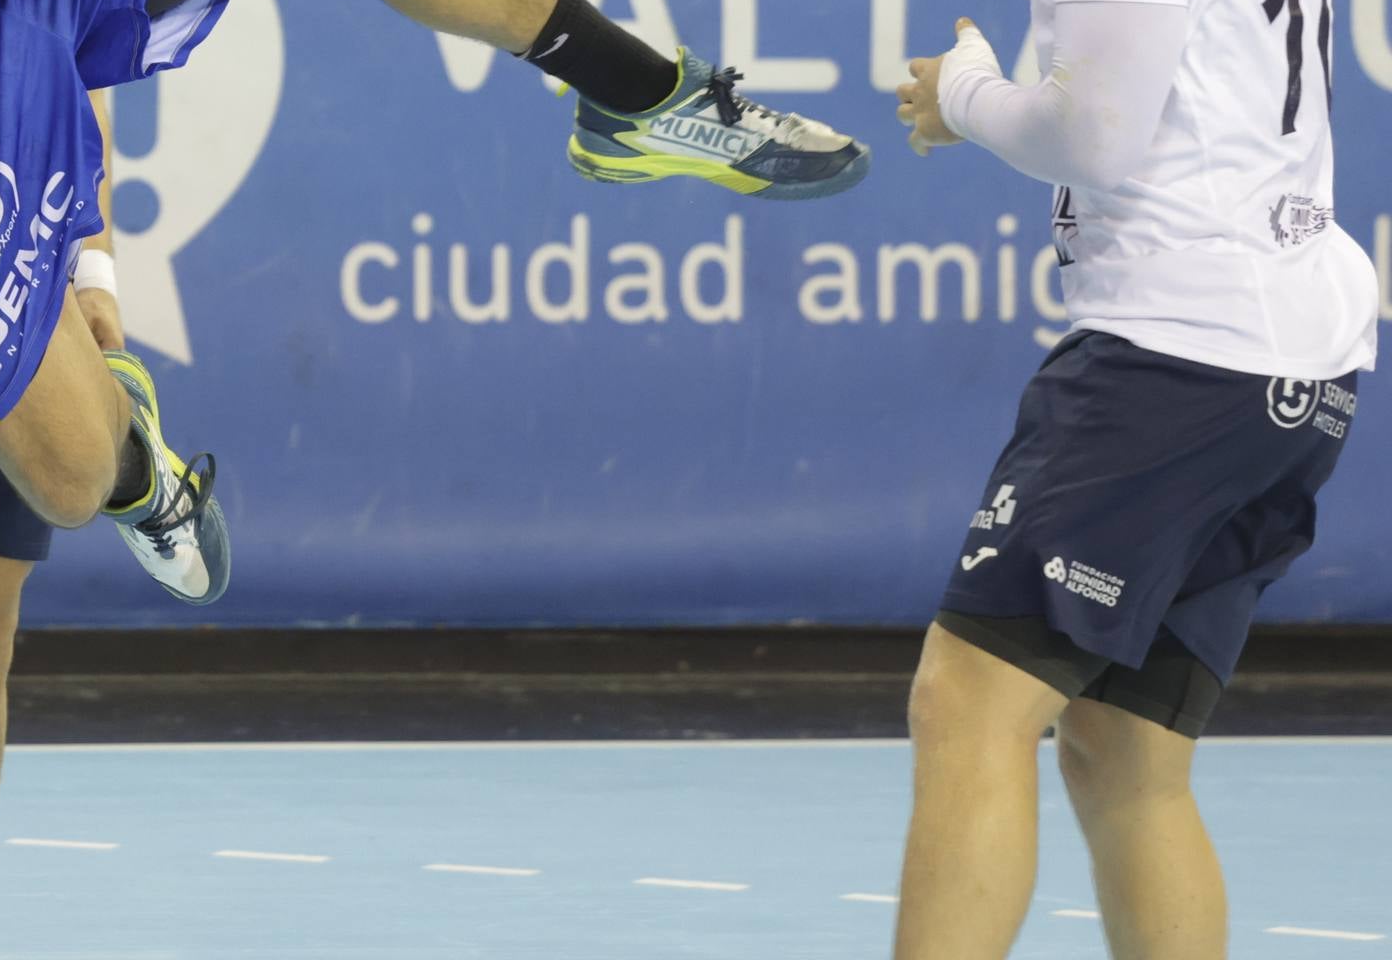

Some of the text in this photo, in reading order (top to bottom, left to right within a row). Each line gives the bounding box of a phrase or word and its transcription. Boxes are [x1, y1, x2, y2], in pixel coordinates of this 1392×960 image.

[340, 212, 745, 325] ciudad
[1065, 580, 1118, 608] ALFONSO
[1068, 569, 1122, 597] TRINIDAD
